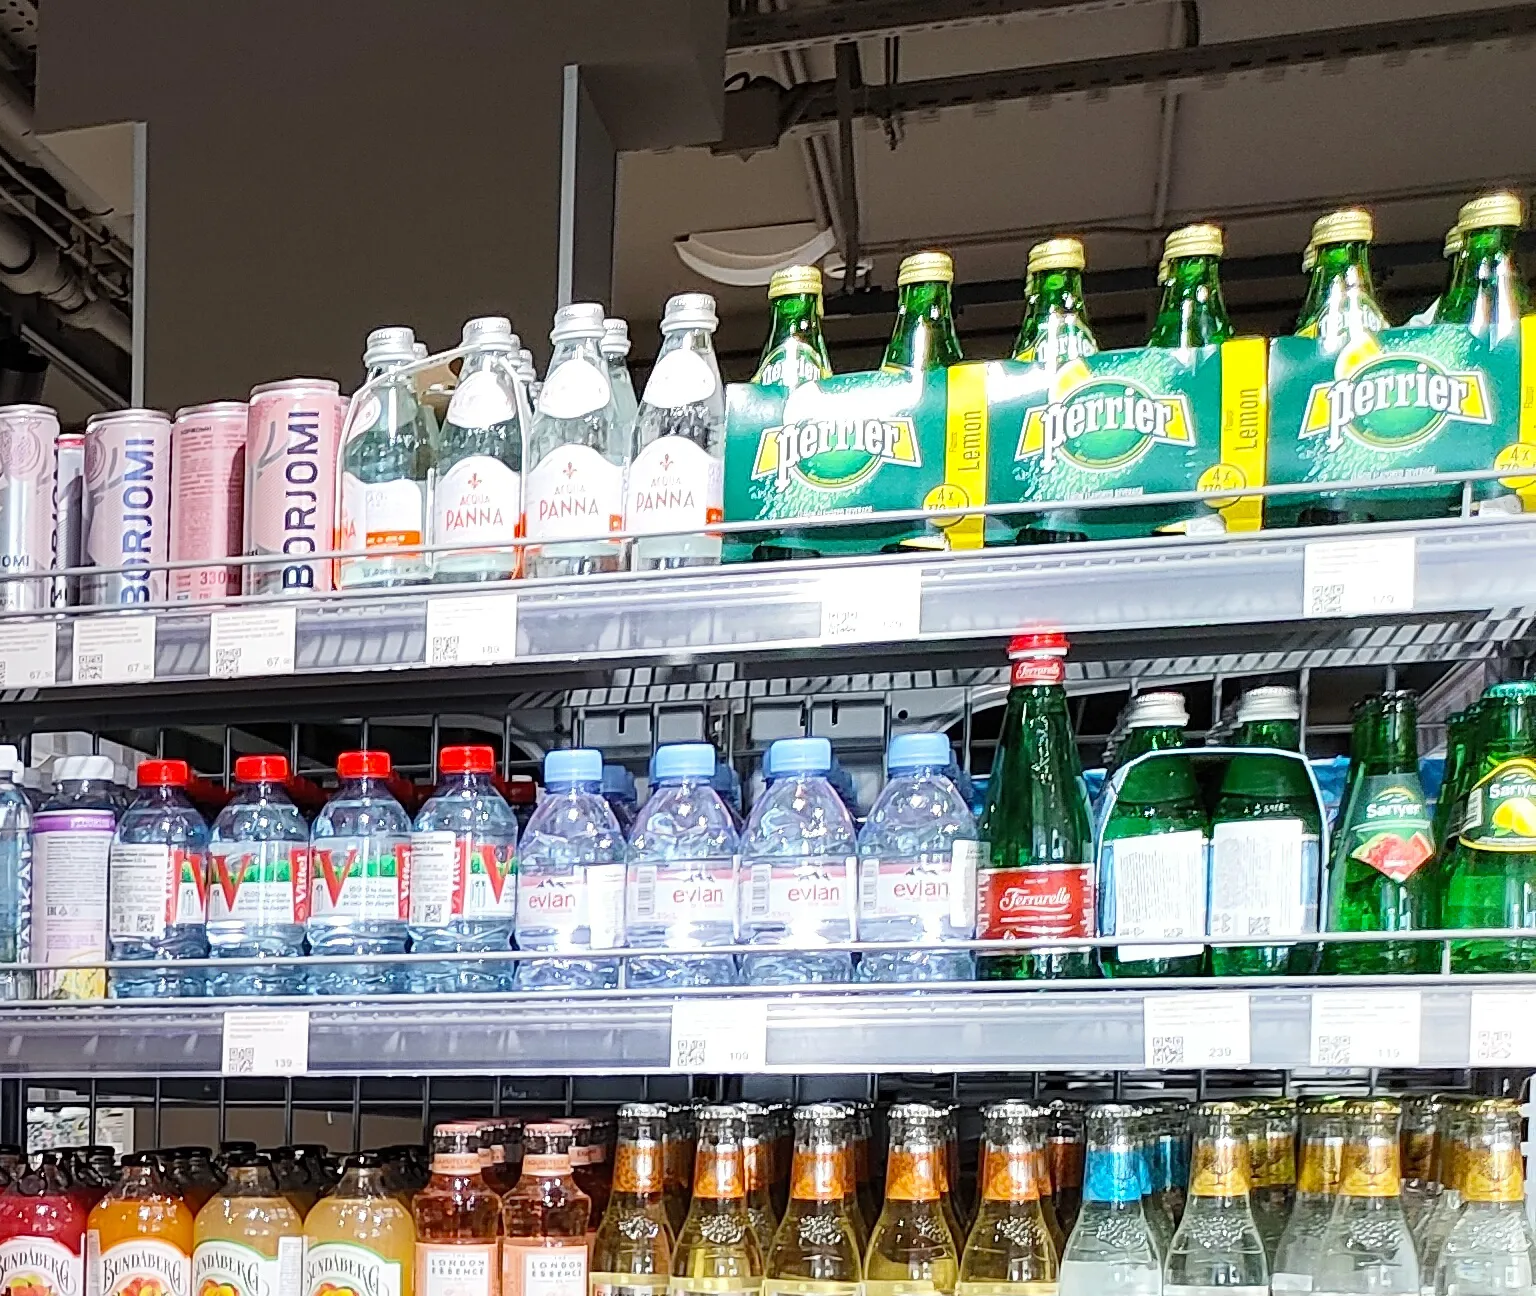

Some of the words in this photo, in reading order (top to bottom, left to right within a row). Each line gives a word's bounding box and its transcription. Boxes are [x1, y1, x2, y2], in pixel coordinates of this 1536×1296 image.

[1041, 385, 1174, 474] perrier
[1233, 387, 1259, 451] Lemon
[1327, 363, 1471, 453] perrier
[776, 415, 902, 493] perrier
[958, 409, 982, 473] Lemon
[121, 437, 156, 605] BORJOMI
[282, 409, 321, 591] BORJOMI
[446, 508, 504, 529] PANNA
[539, 498, 599, 520] PANNA
[636, 490, 695, 512] PANNA
[295, 855, 309, 903] Vittel
[529, 891, 575, 909] evian
[673, 886, 723, 903] evian
[788, 884, 839, 902] evian
[893, 880, 949, 899] evian
[1000, 885, 1071, 912] Ferrarelle
[101, 1248, 187, 1296] BUNDABERG
